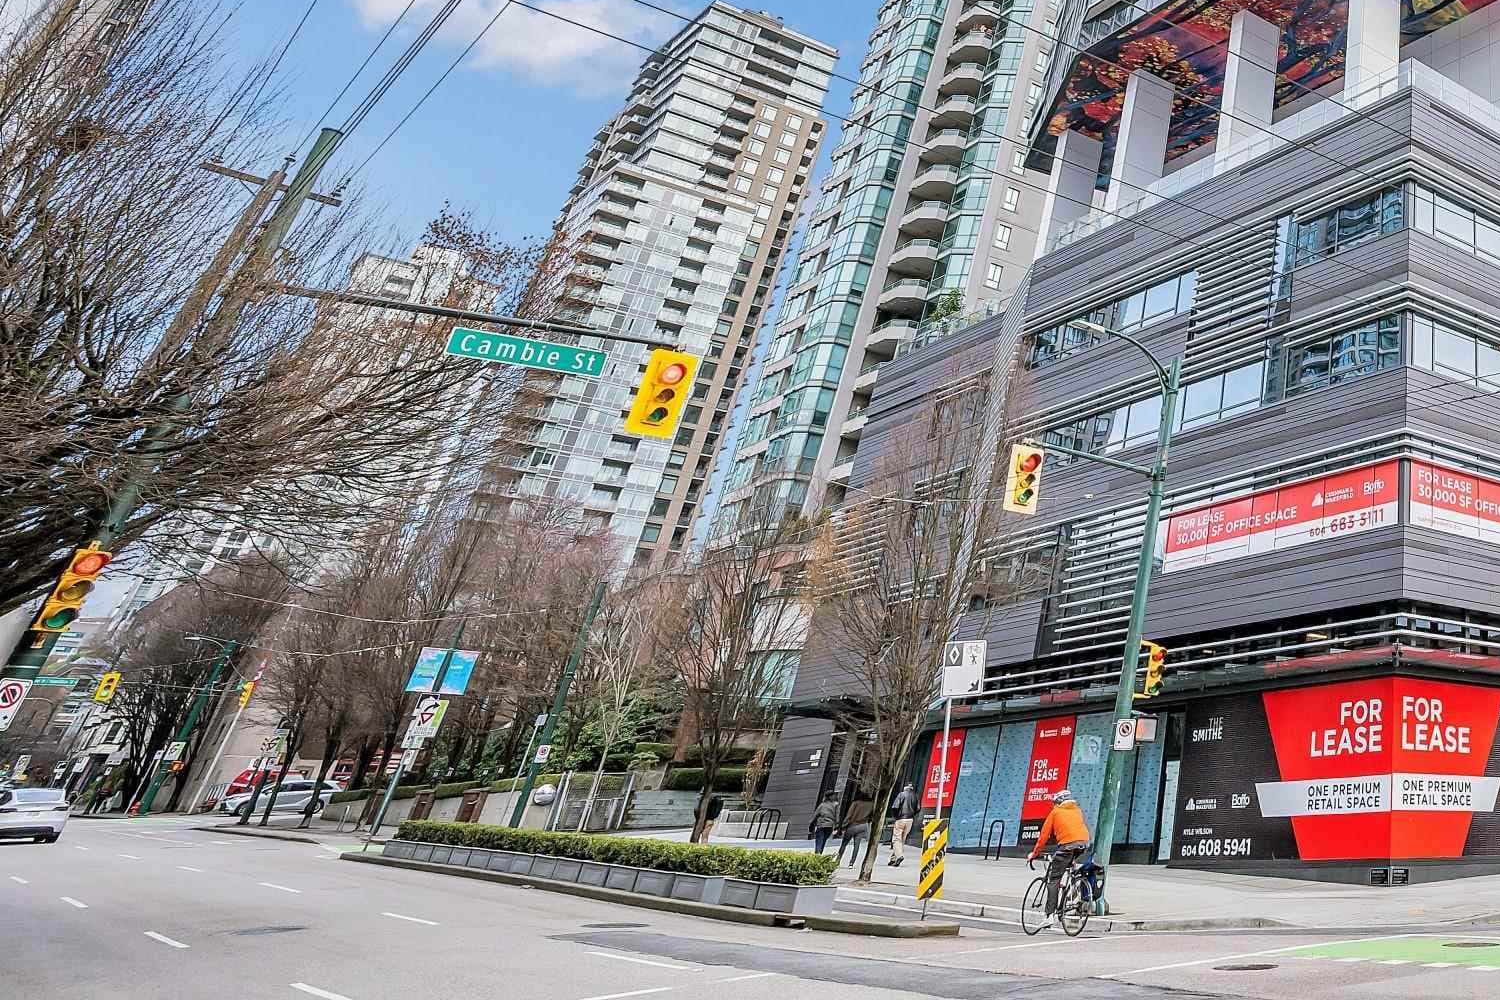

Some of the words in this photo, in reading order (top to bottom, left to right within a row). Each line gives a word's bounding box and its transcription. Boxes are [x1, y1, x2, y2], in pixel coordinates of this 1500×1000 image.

[460, 334, 560, 365] Cambie
[571, 353, 596, 372] St
[1418, 470, 1439, 486] FOR
[1441, 476, 1472, 493] LEASE
[1418, 486, 1457, 504] 30,000
[1459, 496, 1472, 508] SF
[1176, 528, 1209, 545] 30,000
[1211, 525, 1224, 537] SF
[1226, 515, 1262, 533] OFFICE
[1263, 506, 1297, 524] SPACE
[1177, 519, 1195, 531] FOR
[1197, 511, 1225, 527] LEASE
[1340, 699, 1383, 726] FOR
[1402, 695, 1443, 722] FOR
[1208, 716, 1224, 729] THE
[1192, 727, 1223, 742] SMITHE
[1310, 724, 1383, 758] LEASE
[1401, 722, 1471, 753] LEASE
[1033, 759, 1048, 769] FOR
[1031, 768, 1059, 782] LEASE
[1307, 783, 1329, 798] ONE
[1332, 781, 1381, 796] PREMIUM
[1402, 780, 1424, 791] ONE
[1427, 780, 1472, 793] PREMIUM
[1307, 797, 1343, 811] RETAIL
[1346, 795, 1380, 809] SPACE
[1402, 793, 1438, 806] RETAIL
[1441, 794, 1472, 806] SPACE
[1181, 845, 1197, 857] 604
[1198, 839, 1221, 856] 608
[1223, 838, 1251, 855] 5941
